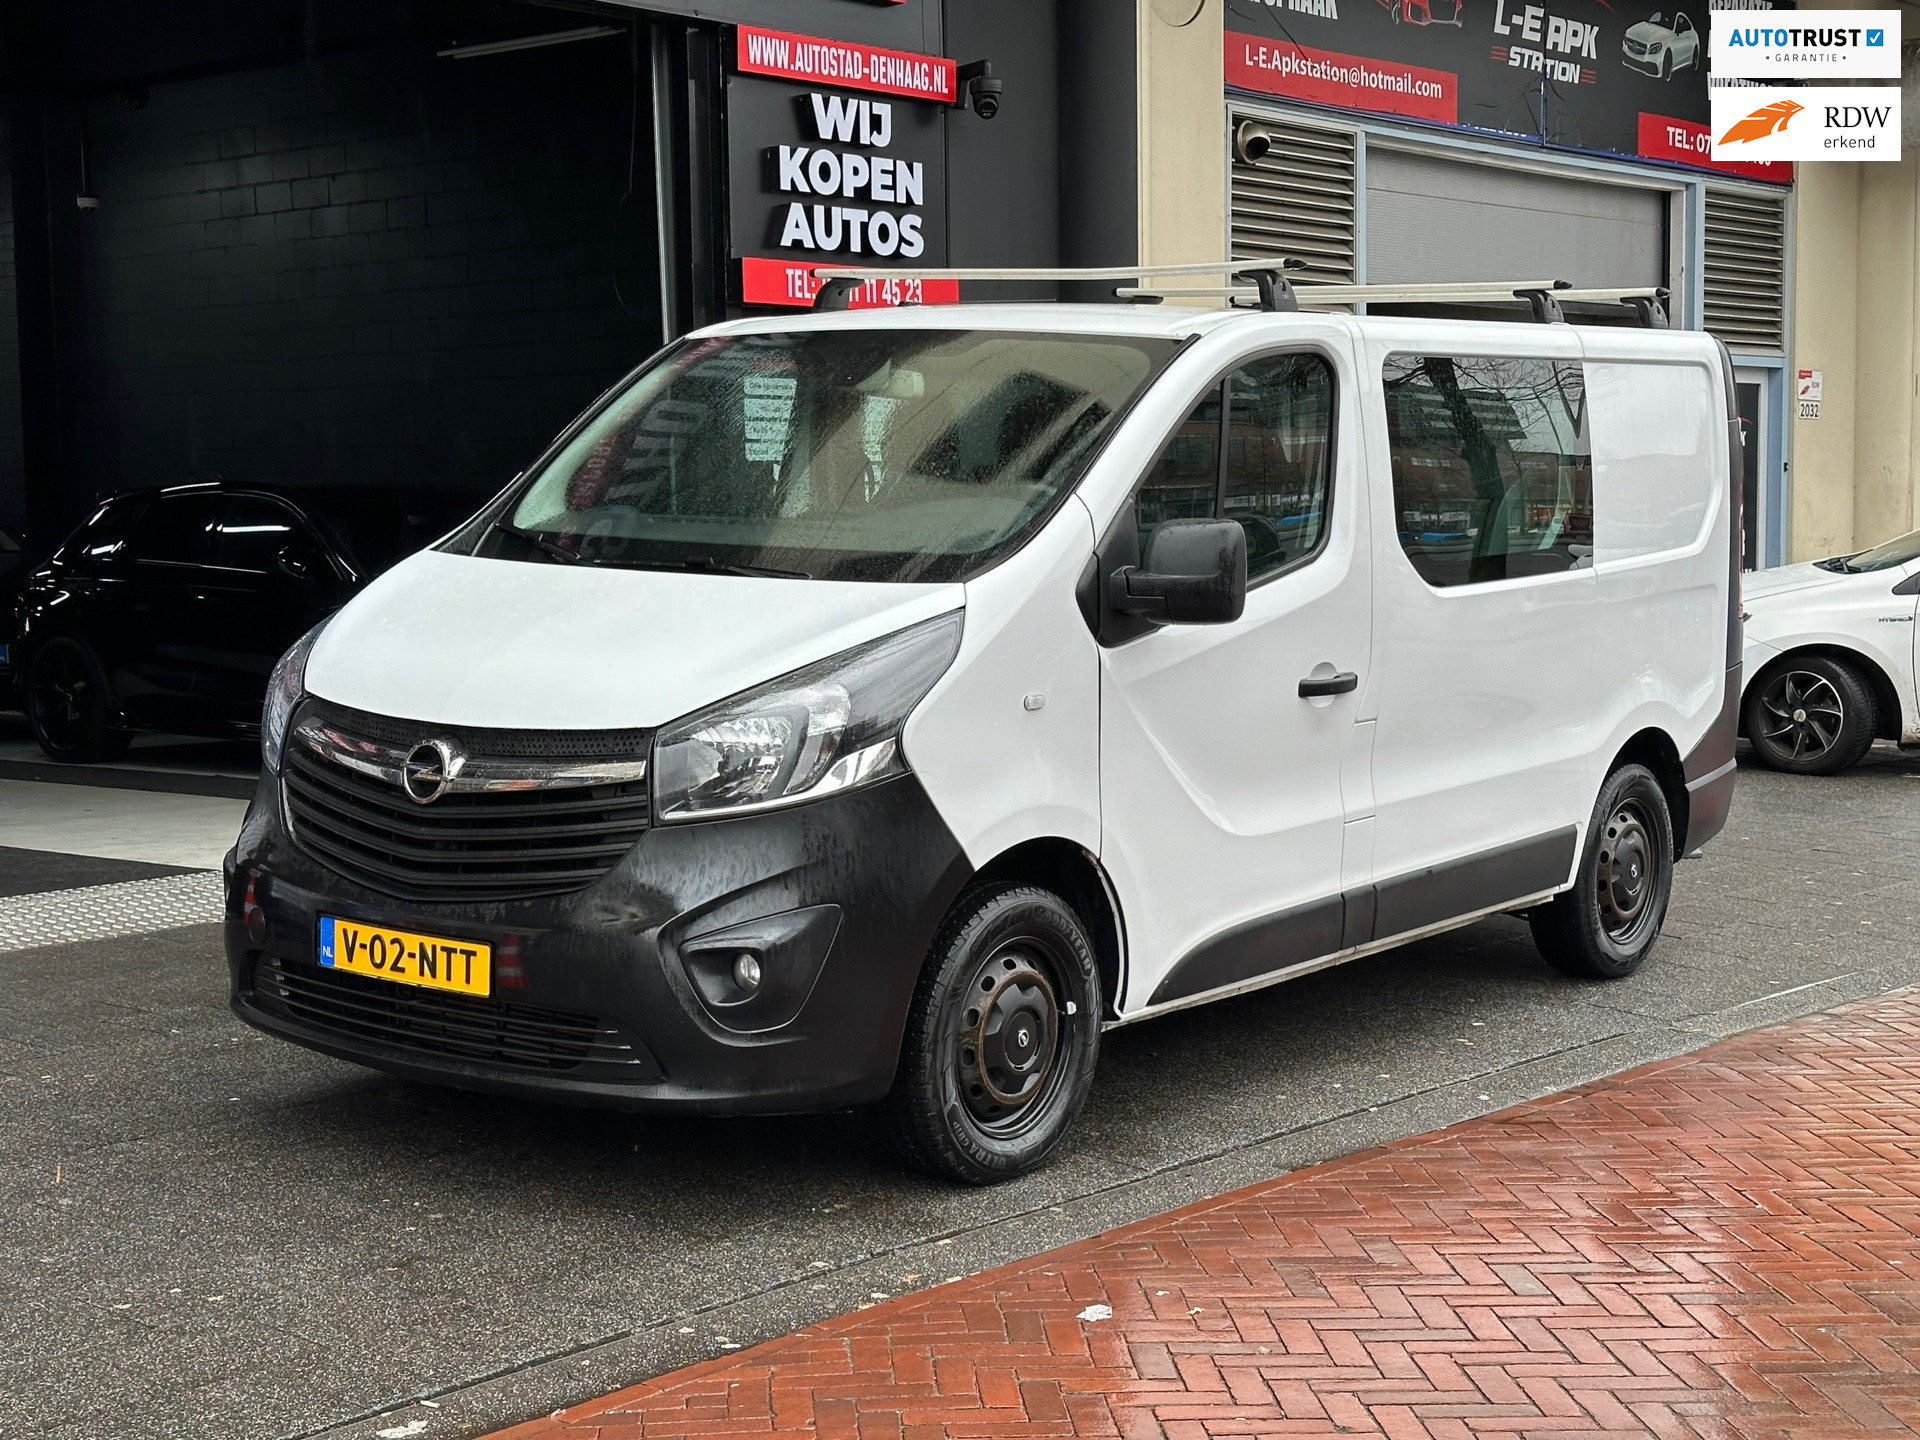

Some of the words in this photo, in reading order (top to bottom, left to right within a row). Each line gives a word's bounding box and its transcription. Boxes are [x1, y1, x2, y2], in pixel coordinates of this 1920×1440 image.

[1494, 0, 1544, 42] L-E
[1546, 15, 1599, 59] APK
[747, 33, 949, 94] WWW.AUTOSTAD-DENHAAG.NL
[1245, 44, 1443, 99] L-E.Apkstation@hotmail.com
[1508, 46, 1580, 84] STATION
[811, 92, 892, 148] WIJ
[1666, 126, 1694, 151] TEL:
[779, 145, 924, 205] KOPEN
[780, 202, 925, 258] AUTOS
[785, 268, 816, 300] TEL:
[882, 279, 901, 306] 45
[905, 279, 923, 304] 23
[1800, 403, 1819, 418] 2032
[322, 946, 334, 958] NL
[342, 927, 478, 985] V-02-NTT
